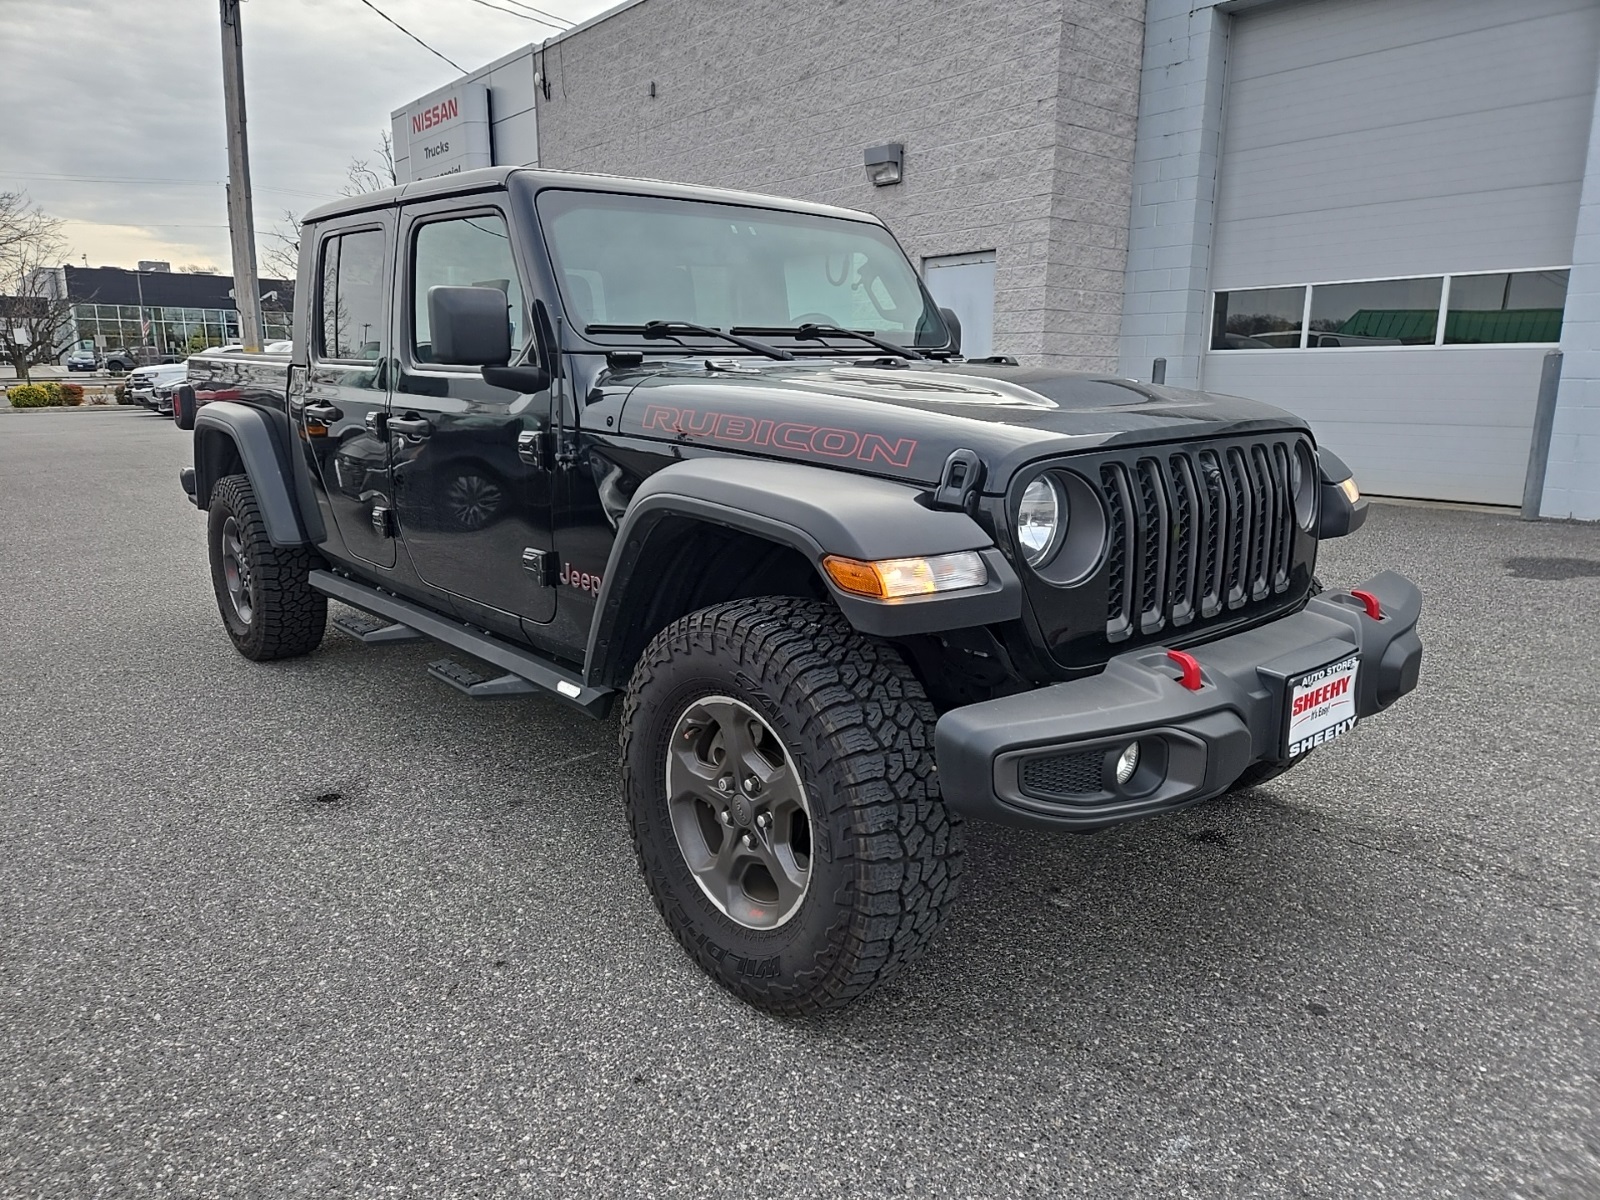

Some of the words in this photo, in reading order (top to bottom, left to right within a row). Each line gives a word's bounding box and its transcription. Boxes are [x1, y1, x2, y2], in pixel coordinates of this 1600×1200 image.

[412, 97, 458, 134] NISSAN
[424, 141, 449, 160] Trucks
[642, 404, 918, 467] RUBICON
[560, 562, 602, 598] Jeep
[1301, 671, 1325, 687] AUTO
[1326, 657, 1357, 676] STORES
[1292, 675, 1351, 716] SHEEHY
[1289, 716, 1358, 758] SHEEHY
